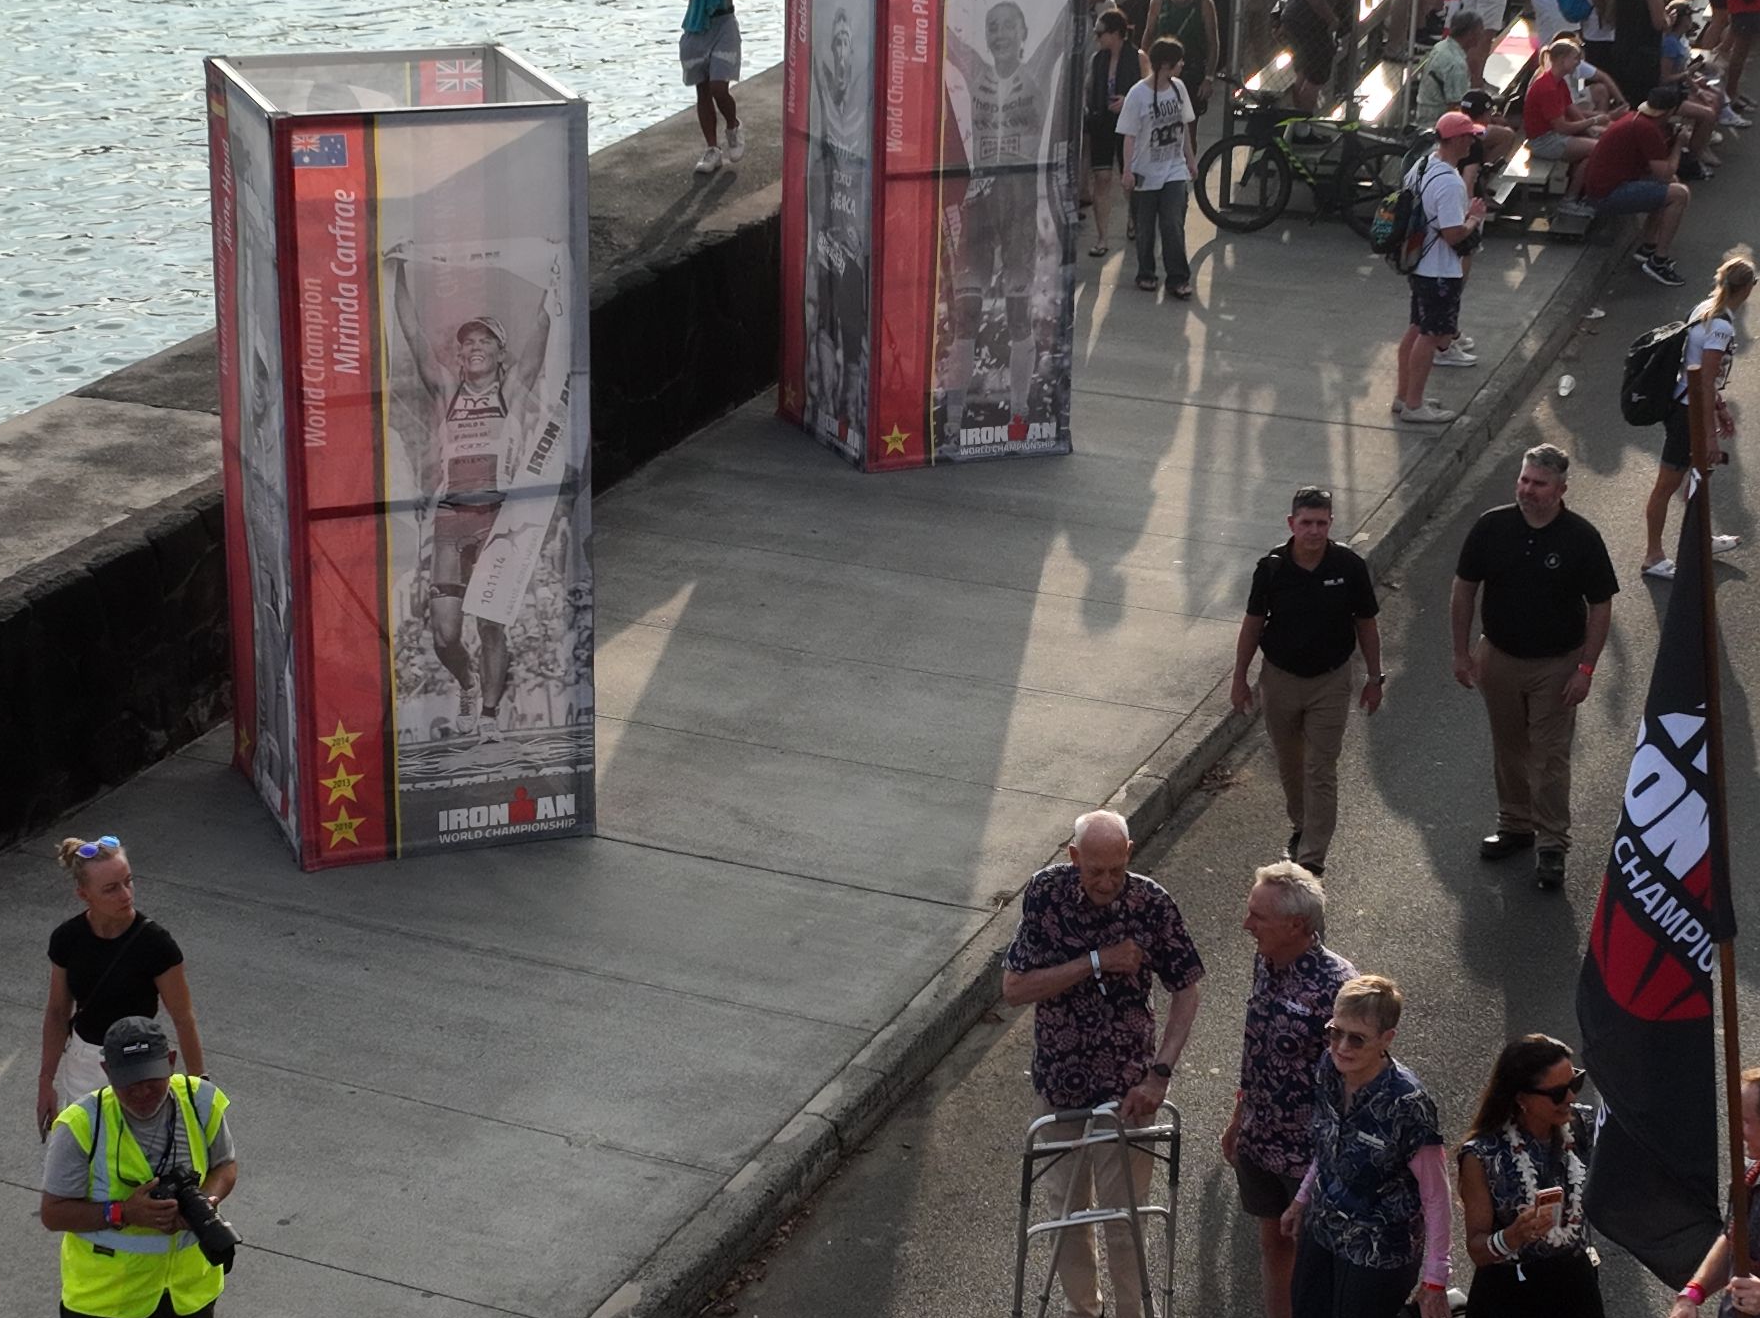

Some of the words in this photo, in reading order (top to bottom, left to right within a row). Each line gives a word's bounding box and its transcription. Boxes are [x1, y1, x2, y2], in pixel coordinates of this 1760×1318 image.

[888, 24, 909, 102] Champion
[912, 19, 927, 64] Laura
[886, 104, 903, 153] World
[223, 200, 233, 253] Anne
[329, 189, 355, 277] Carfrae
[299, 277, 326, 385] Champion
[333, 281, 360, 375] Mirinda
[304, 387, 327, 449] World
[960, 413, 1056, 446] IRONMAN
[960, 445, 991, 456] WORLD
[991, 440, 1056, 453] CHAMPIONSHIP
[438, 785, 576, 832] IRONMAN
[439, 828, 482, 844] WORLD
[485, 817, 576, 838] CHAMPIONSHIP
